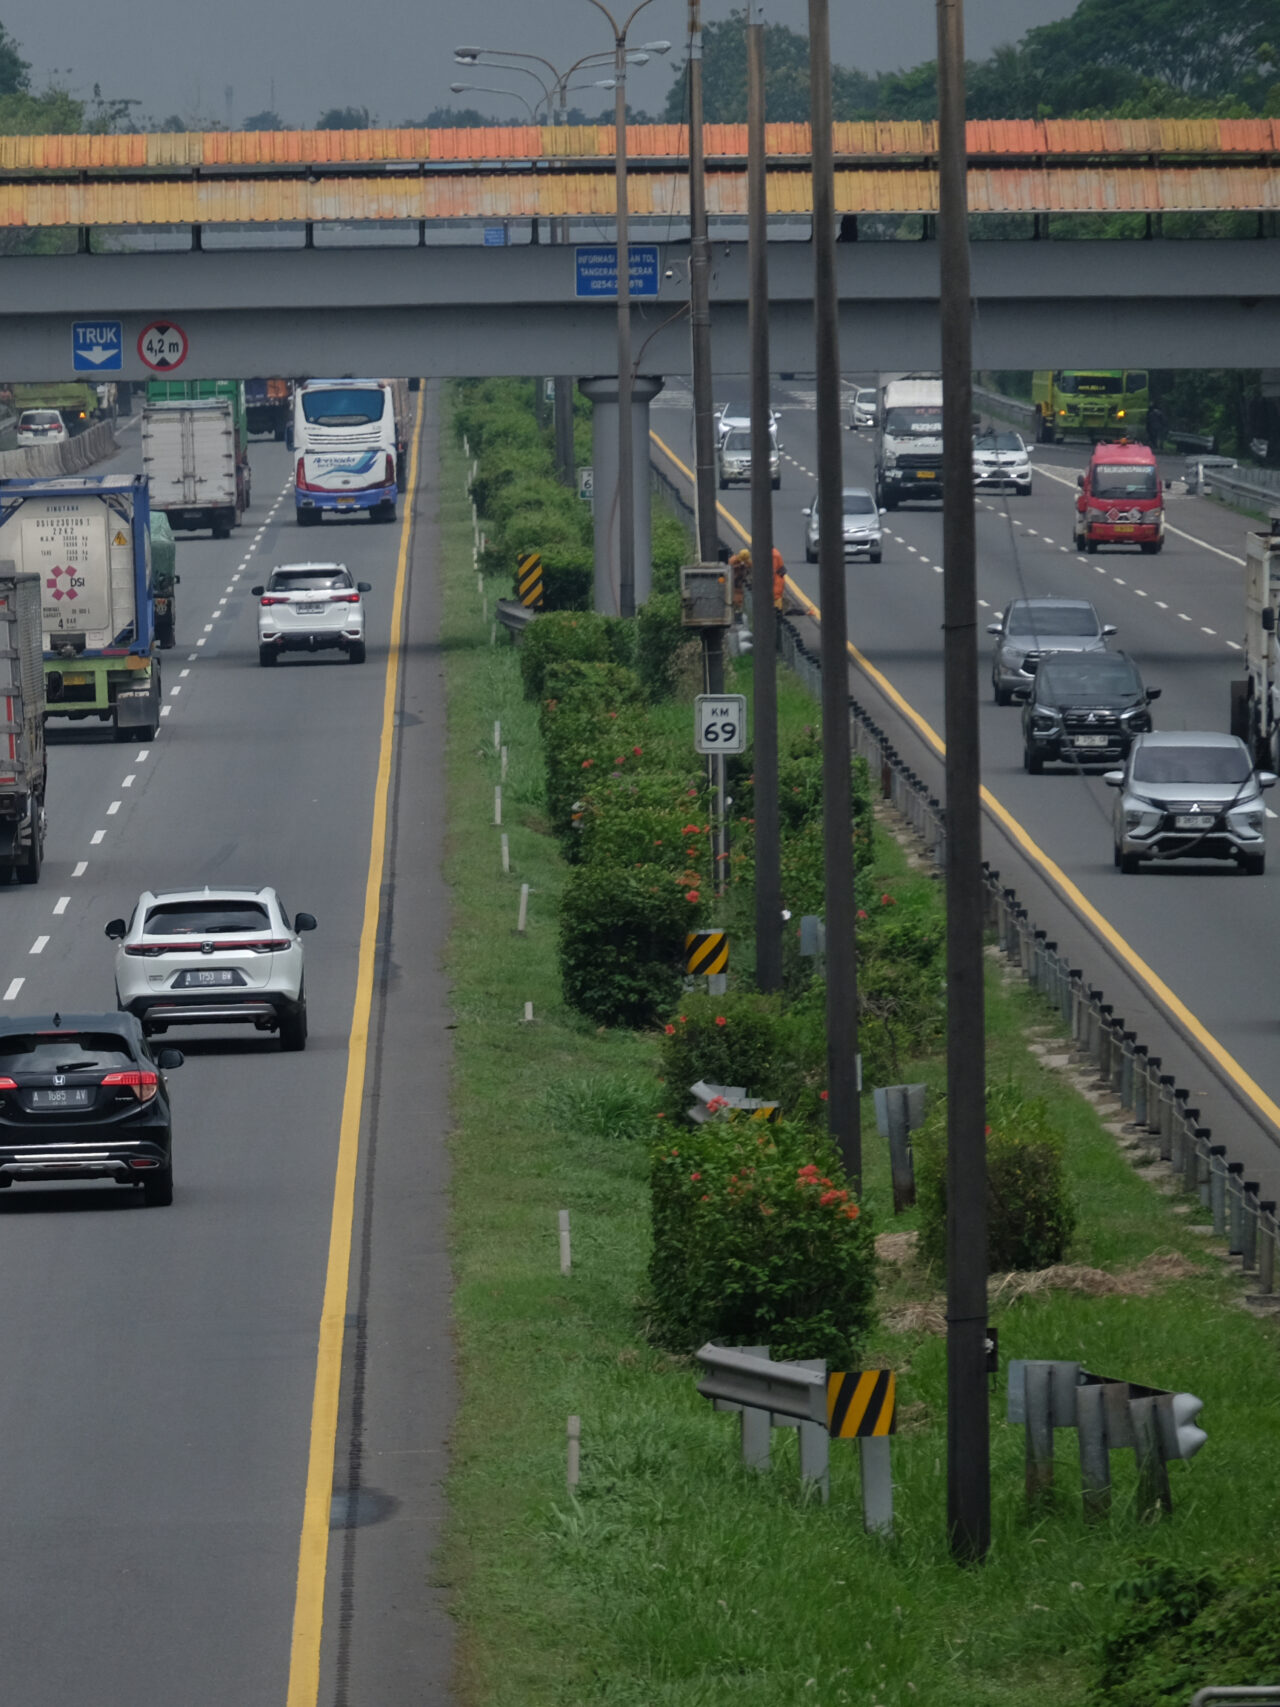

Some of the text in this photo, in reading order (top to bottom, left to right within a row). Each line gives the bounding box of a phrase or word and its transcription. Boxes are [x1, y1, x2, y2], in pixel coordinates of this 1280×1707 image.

[642, 254, 655, 263] TOL
[76, 327, 118, 344] TRUK
[146, 338, 180, 356] 4,2 m
[70, 578, 85, 588] DSI
[58, 618, 64, 629] 4
[712, 708, 729, 717] KM
[704, 722, 736, 742] 69
[34, 1092, 38, 1101] A
